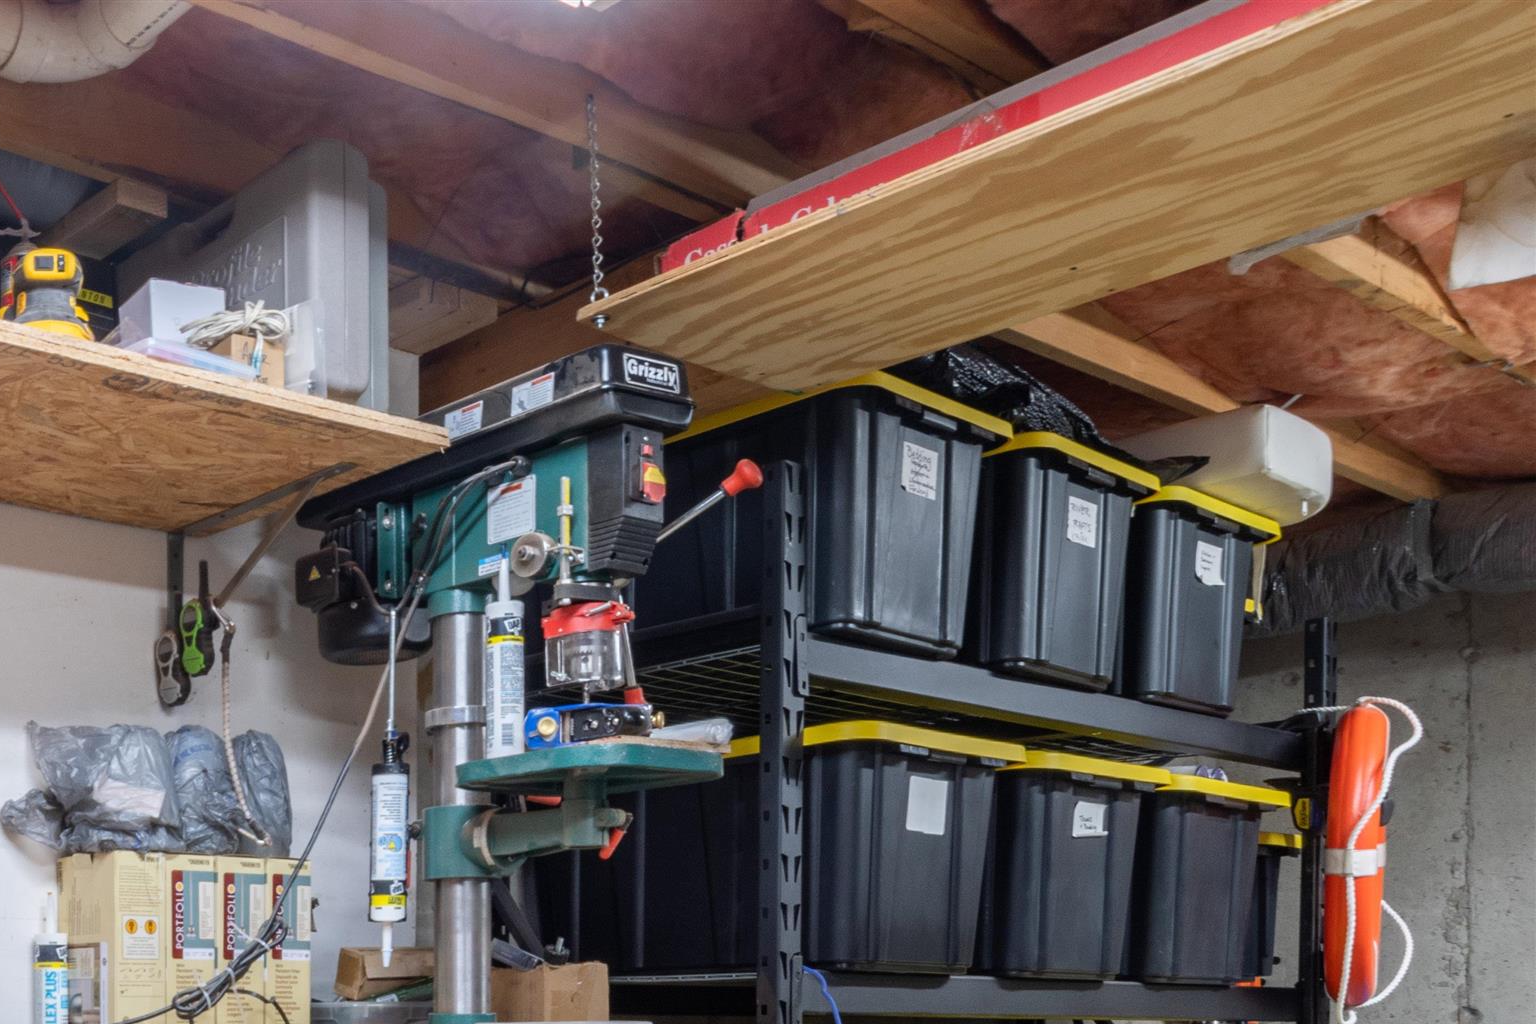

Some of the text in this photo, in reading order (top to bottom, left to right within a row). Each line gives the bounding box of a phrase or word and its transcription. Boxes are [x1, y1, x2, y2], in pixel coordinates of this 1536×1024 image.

[627, 358, 676, 387] Grizzly
[175, 880, 184, 950] PORTFOLIO
[227, 883, 236, 951] PORTFOLIO
[45, 970, 57, 999] PLUS
